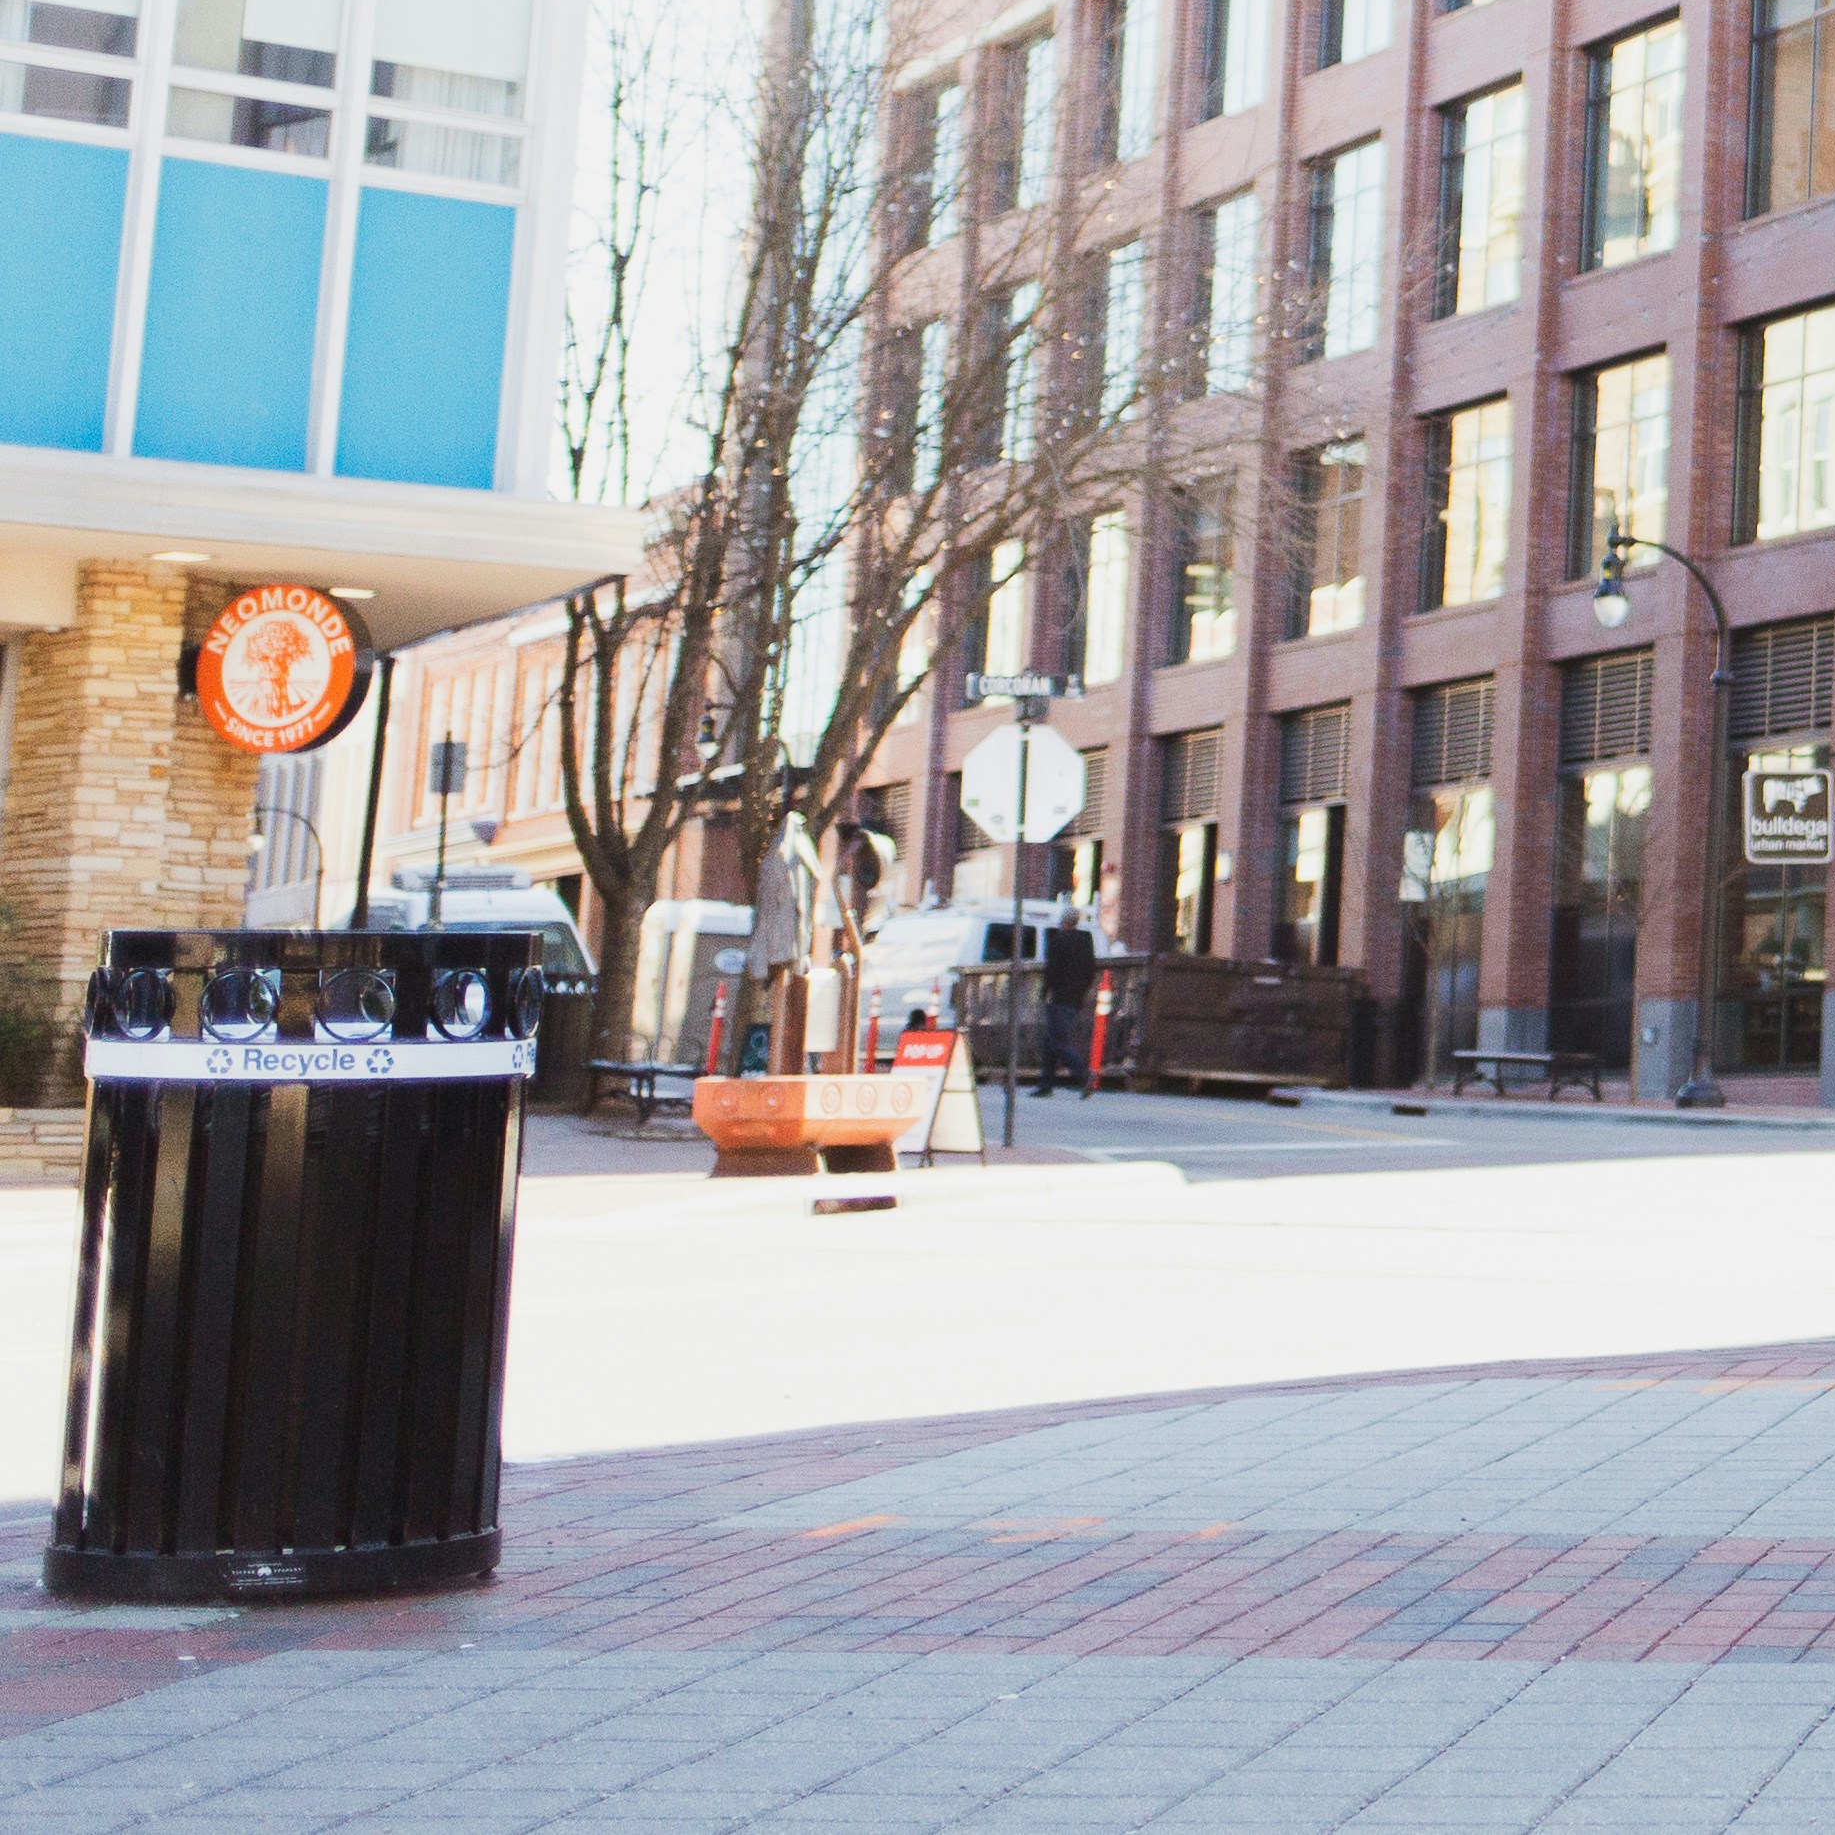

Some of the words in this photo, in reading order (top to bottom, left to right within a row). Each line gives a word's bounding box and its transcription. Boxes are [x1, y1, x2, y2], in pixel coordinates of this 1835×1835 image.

[206, 587, 350, 658] NEOMONDE
[224, 717, 275, 747] SINCE
[278, 716, 313, 745] 1977
[1751, 815, 1828, 841] bulldega
[243, 1048, 356, 1076] Recycle
